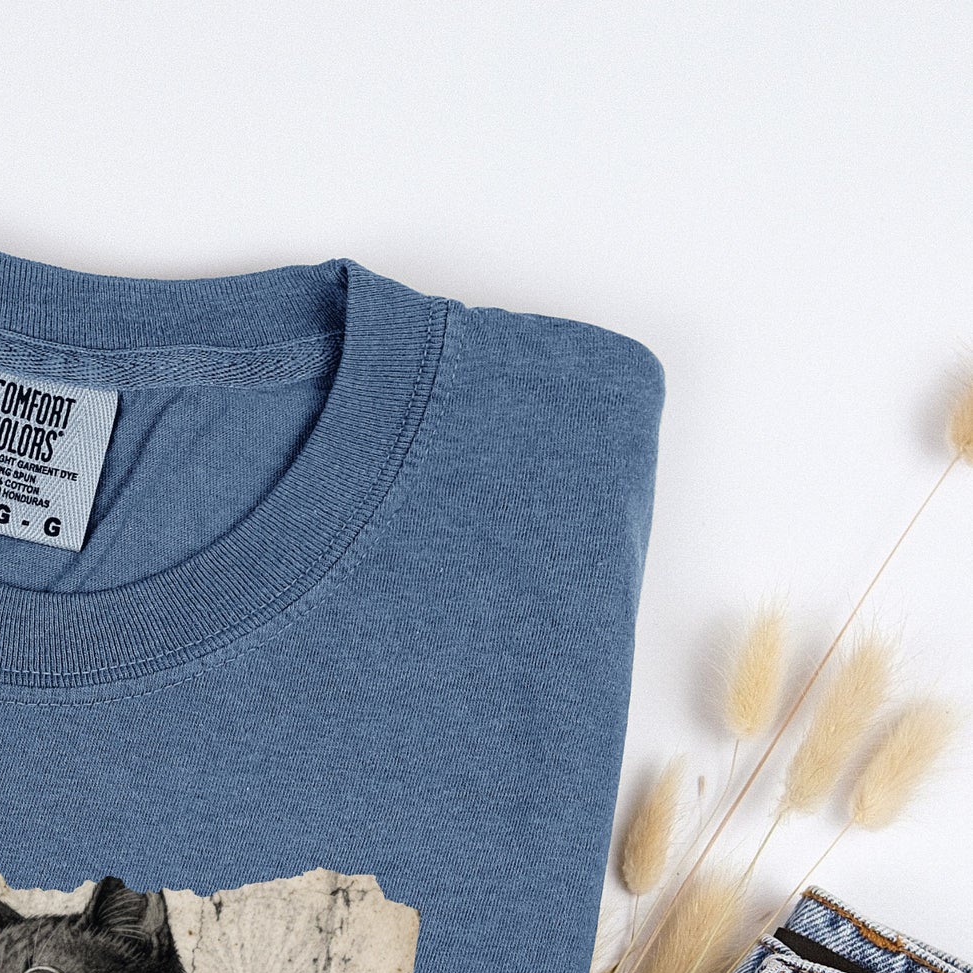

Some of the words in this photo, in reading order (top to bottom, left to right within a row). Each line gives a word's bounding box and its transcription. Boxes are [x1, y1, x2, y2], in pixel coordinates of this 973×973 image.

[12, 471, 37, 484] SPUN
[17, 460, 60, 477] GARMENT
[60, 470, 79, 482] DYE
[4, 479, 40, 495] COTTON
[2, 489, 51, 509] HONDURAS
[43, 516, 62, 537] G
